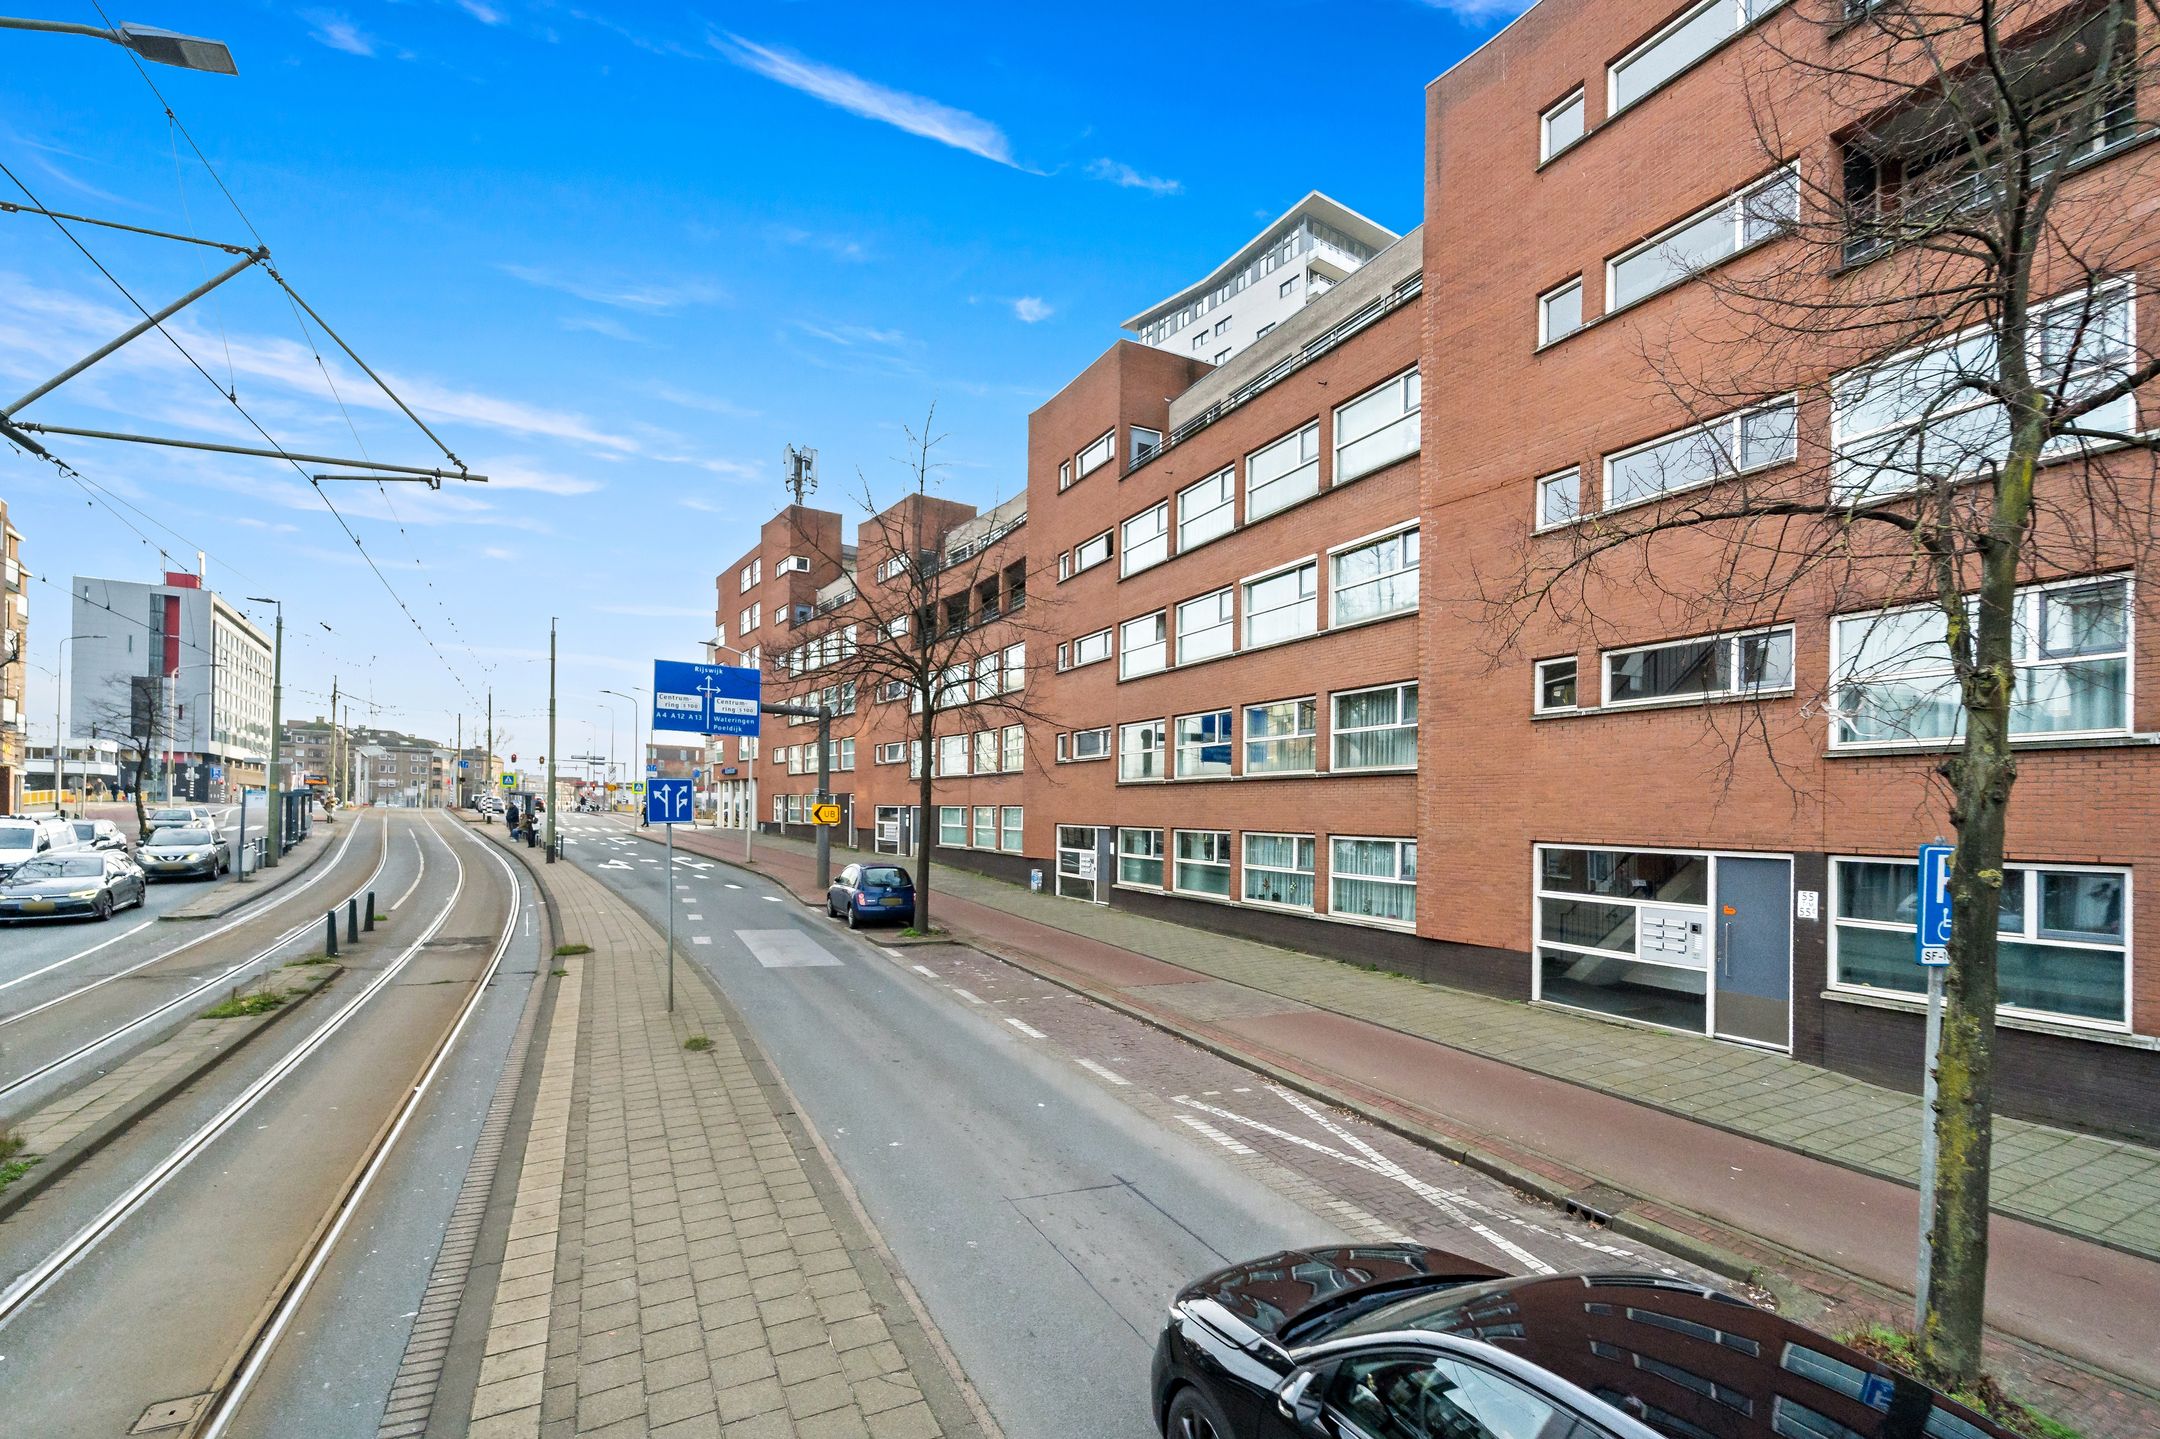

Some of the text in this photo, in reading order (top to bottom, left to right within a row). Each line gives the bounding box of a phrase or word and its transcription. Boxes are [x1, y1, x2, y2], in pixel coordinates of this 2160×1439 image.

[694, 666, 723, 675] Rijswijk
[716, 698, 748, 706] Centrum-
[713, 716, 755, 725] Wateringen
[713, 725, 742, 733] Poeldijk
